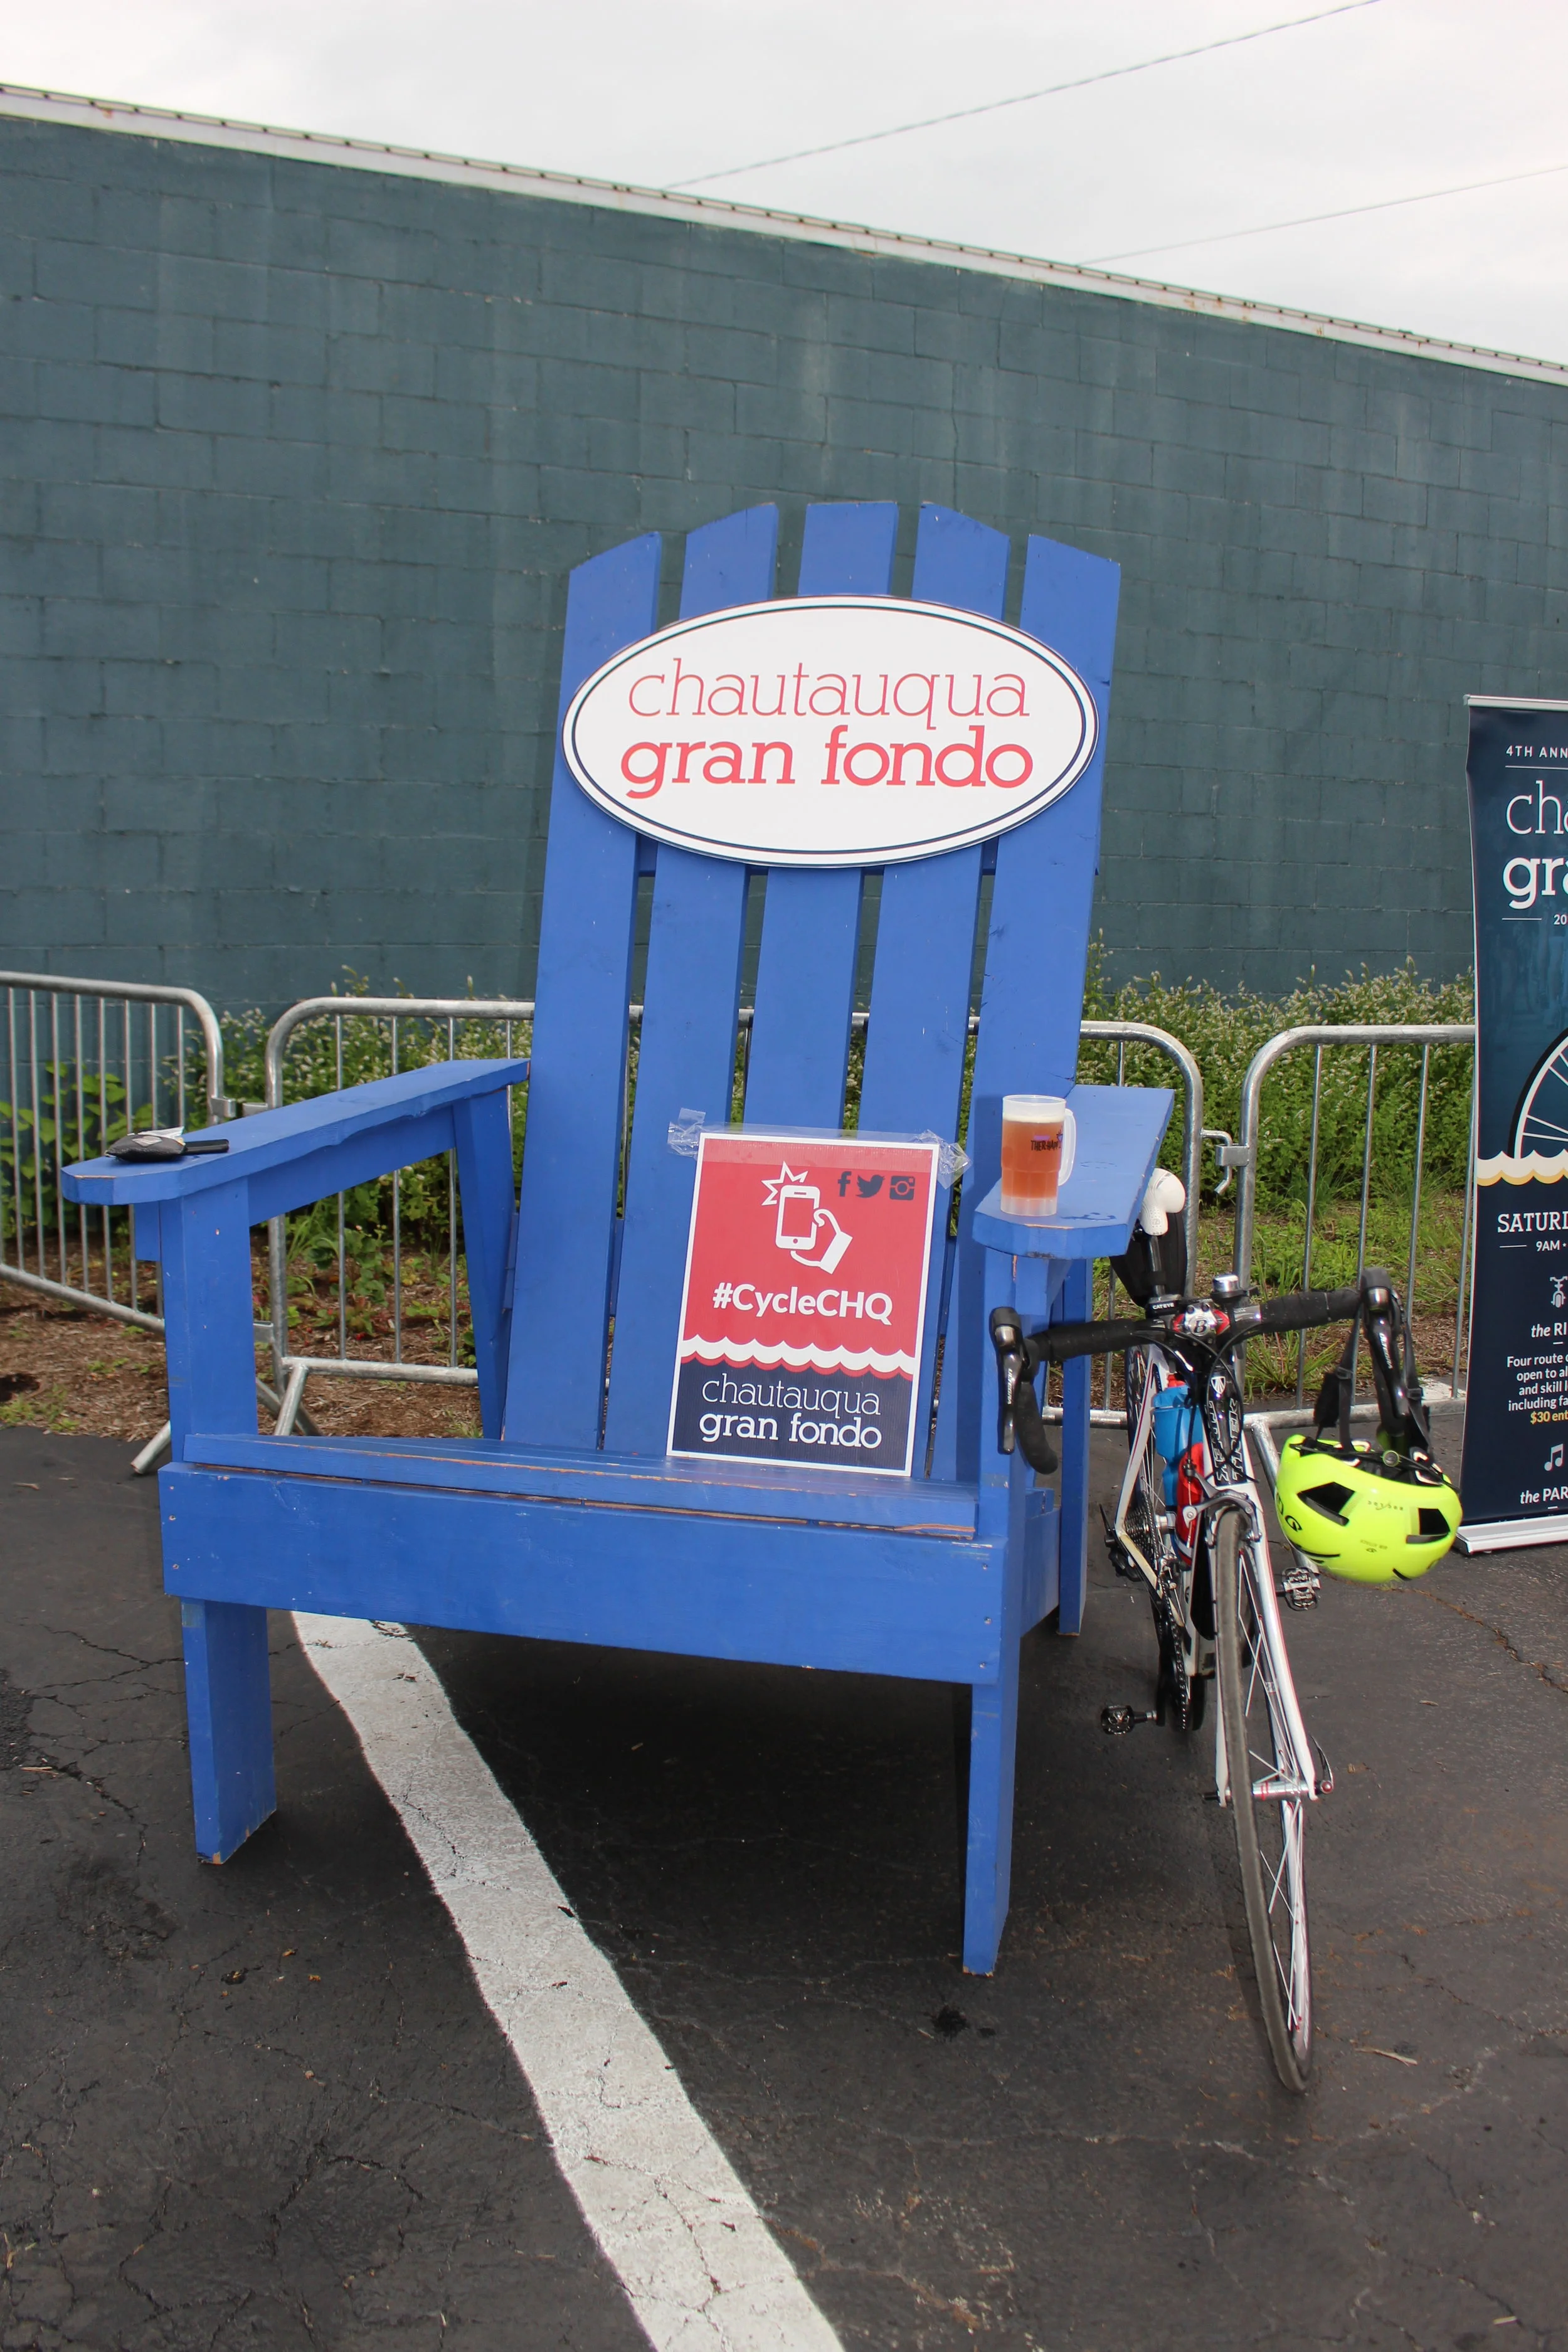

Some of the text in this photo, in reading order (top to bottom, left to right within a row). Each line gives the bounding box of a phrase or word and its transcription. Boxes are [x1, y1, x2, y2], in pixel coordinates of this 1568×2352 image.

[628, 658, 1030, 730] chautauqua
[1506, 745, 1568, 759] 4TH ANN
[620, 724, 1034, 800] gran fondo
[1506, 780, 1568, 835] ch
[1503, 857, 1568, 909] gr
[1536, 1239, 1560, 1252] 9AM
[712, 1282, 893, 1326] #CycleCHQ
[1531, 1324, 1551, 1338] the
[1507, 1356, 1532, 1368] Four
[1534, 1353, 1564, 1365] route
[1516, 1370, 1543, 1383] open
[1545, 1368, 1557, 1379] to
[702, 1372, 881, 1419] chautauqua
[1518, 1382, 1539, 1396] and
[1540, 1380, 1562, 1394] skill
[1508, 1397, 1557, 1411] including
[1530, 1411, 1550, 1424] $30
[699, 1412, 882, 1449] gran fondo
[1520, 1490, 1540, 1504] the
